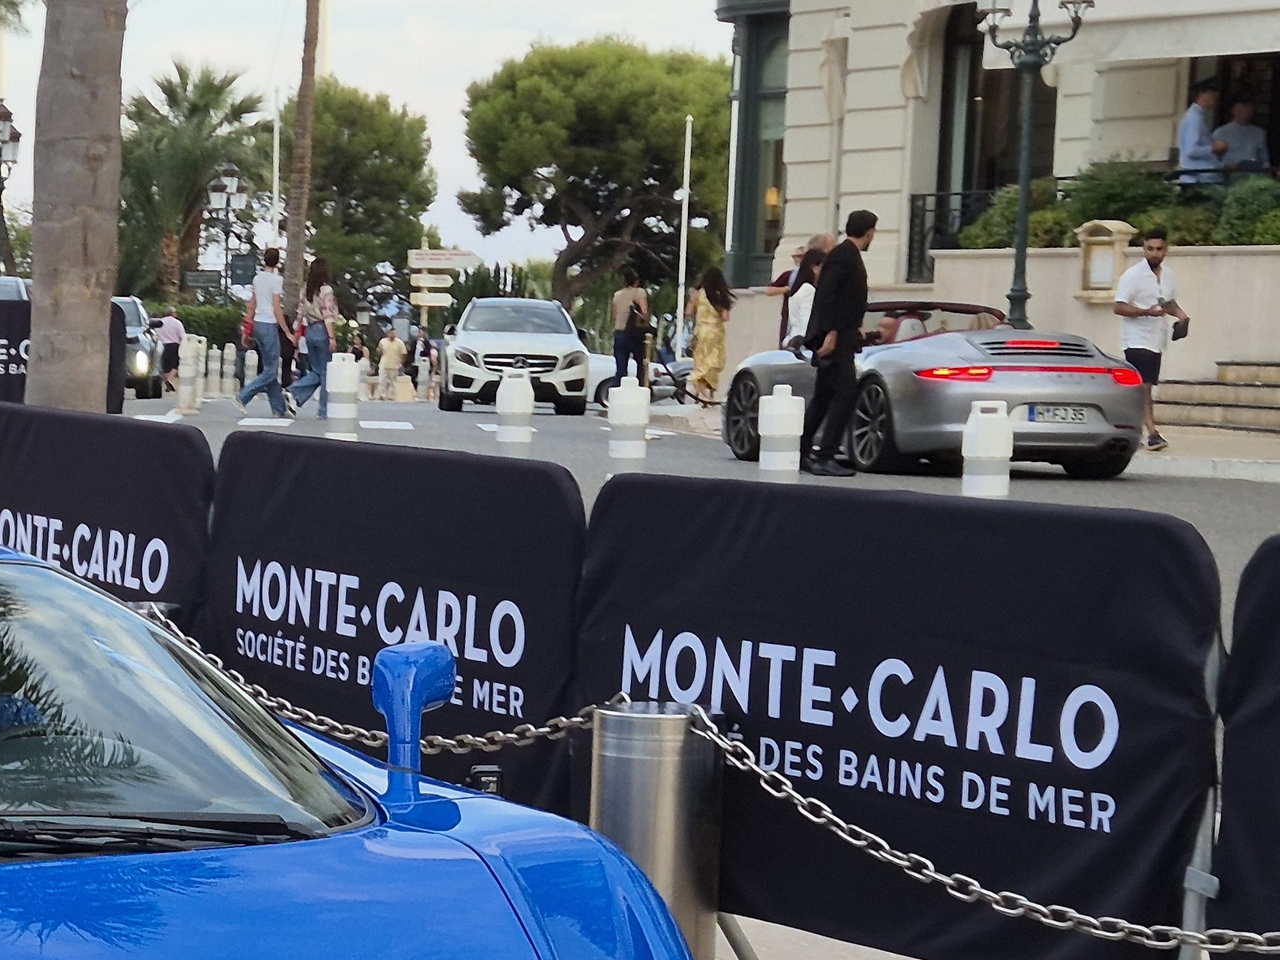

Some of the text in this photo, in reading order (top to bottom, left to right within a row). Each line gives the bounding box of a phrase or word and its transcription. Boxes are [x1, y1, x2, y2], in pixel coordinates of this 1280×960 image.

[235, 627, 307, 672] SOCIÉTÉ
[312, 645, 350, 682] DES
[472, 678, 524, 719] MER
[759, 736, 824, 781] DES
[838, 749, 946, 804] BAINS
[960, 770, 1011, 816] DE
[1027, 782, 1116, 833] MER
